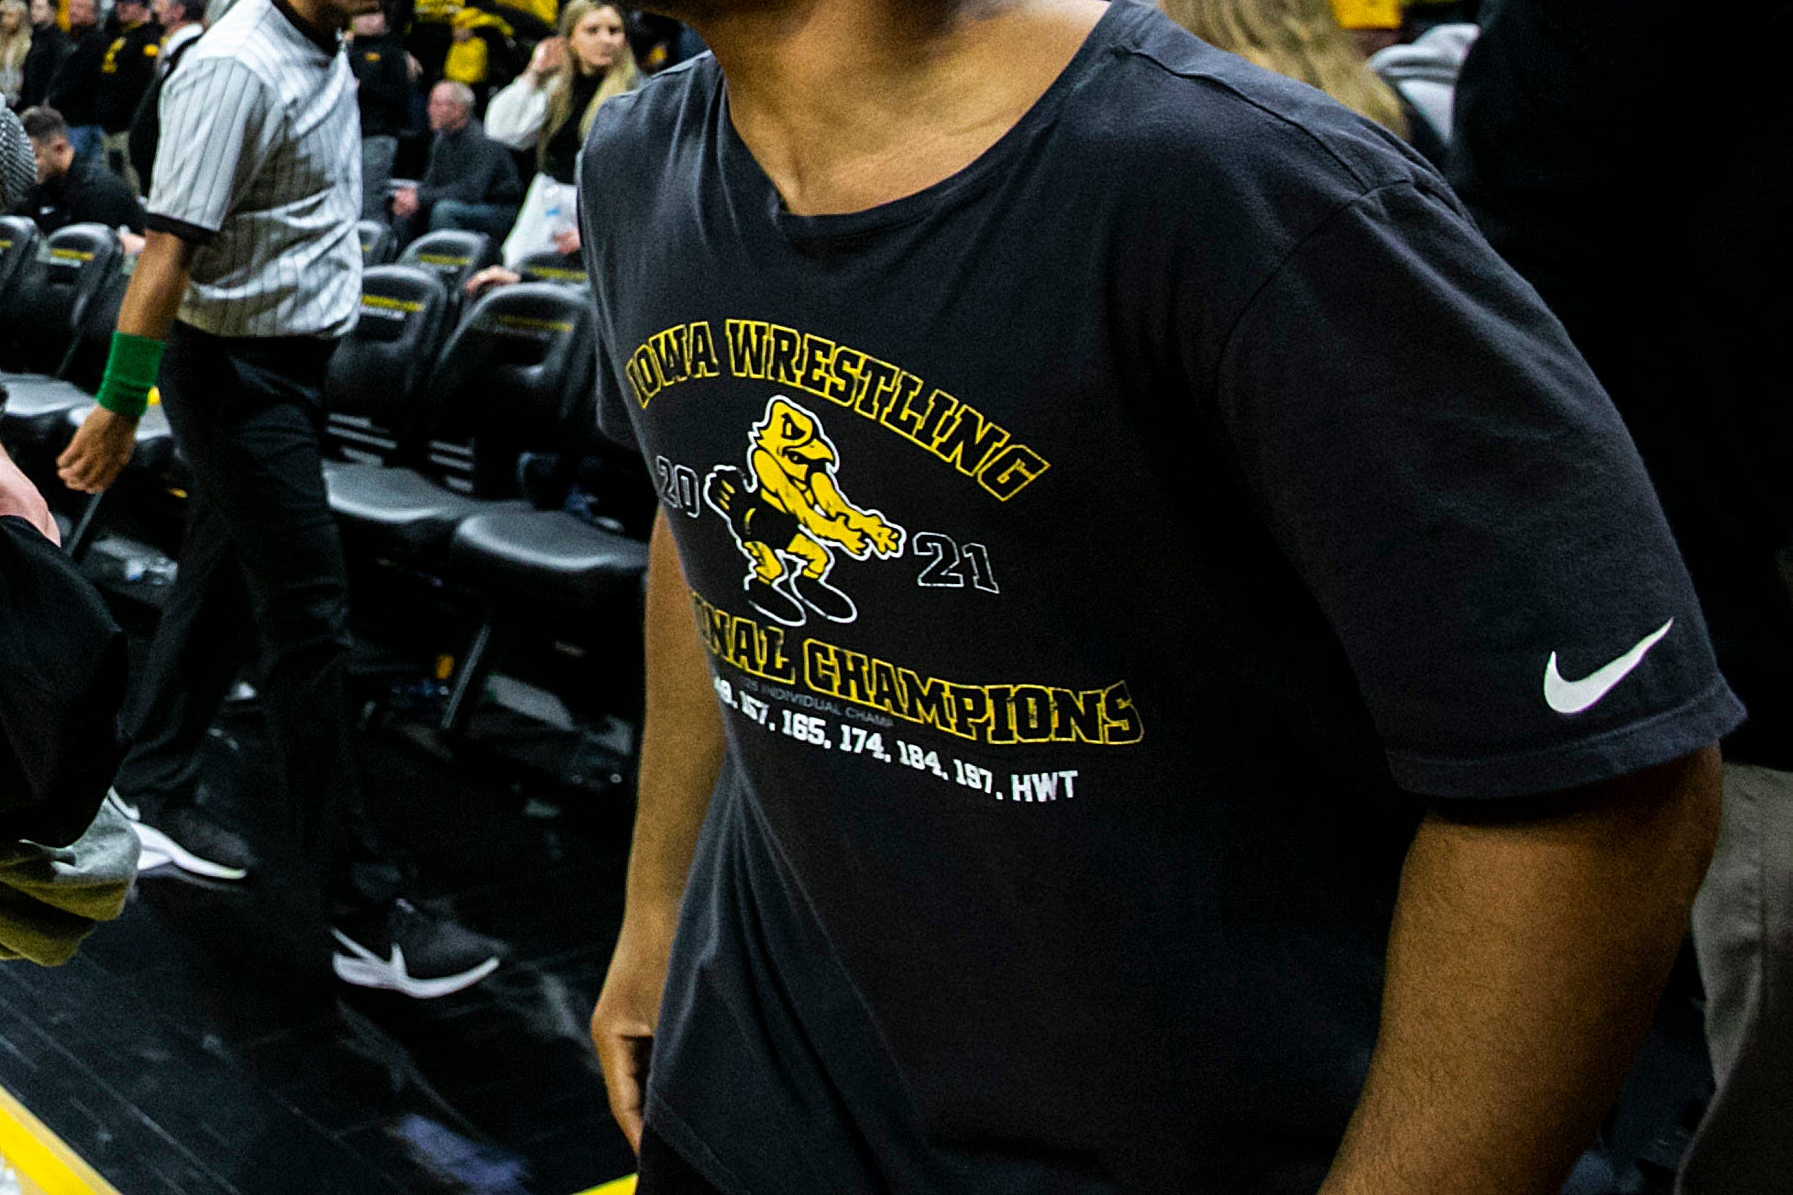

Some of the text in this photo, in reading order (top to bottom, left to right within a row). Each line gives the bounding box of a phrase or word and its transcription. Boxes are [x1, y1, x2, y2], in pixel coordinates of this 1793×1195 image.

[625, 318, 1052, 502] IOWA WRESTLING
[657, 455, 1000, 595] 20 21
[762, 684, 842, 717] INDIVIDUAL
[803, 637, 1145, 745] CHAMPIONS
[1011, 769, 1079, 803] HWT
